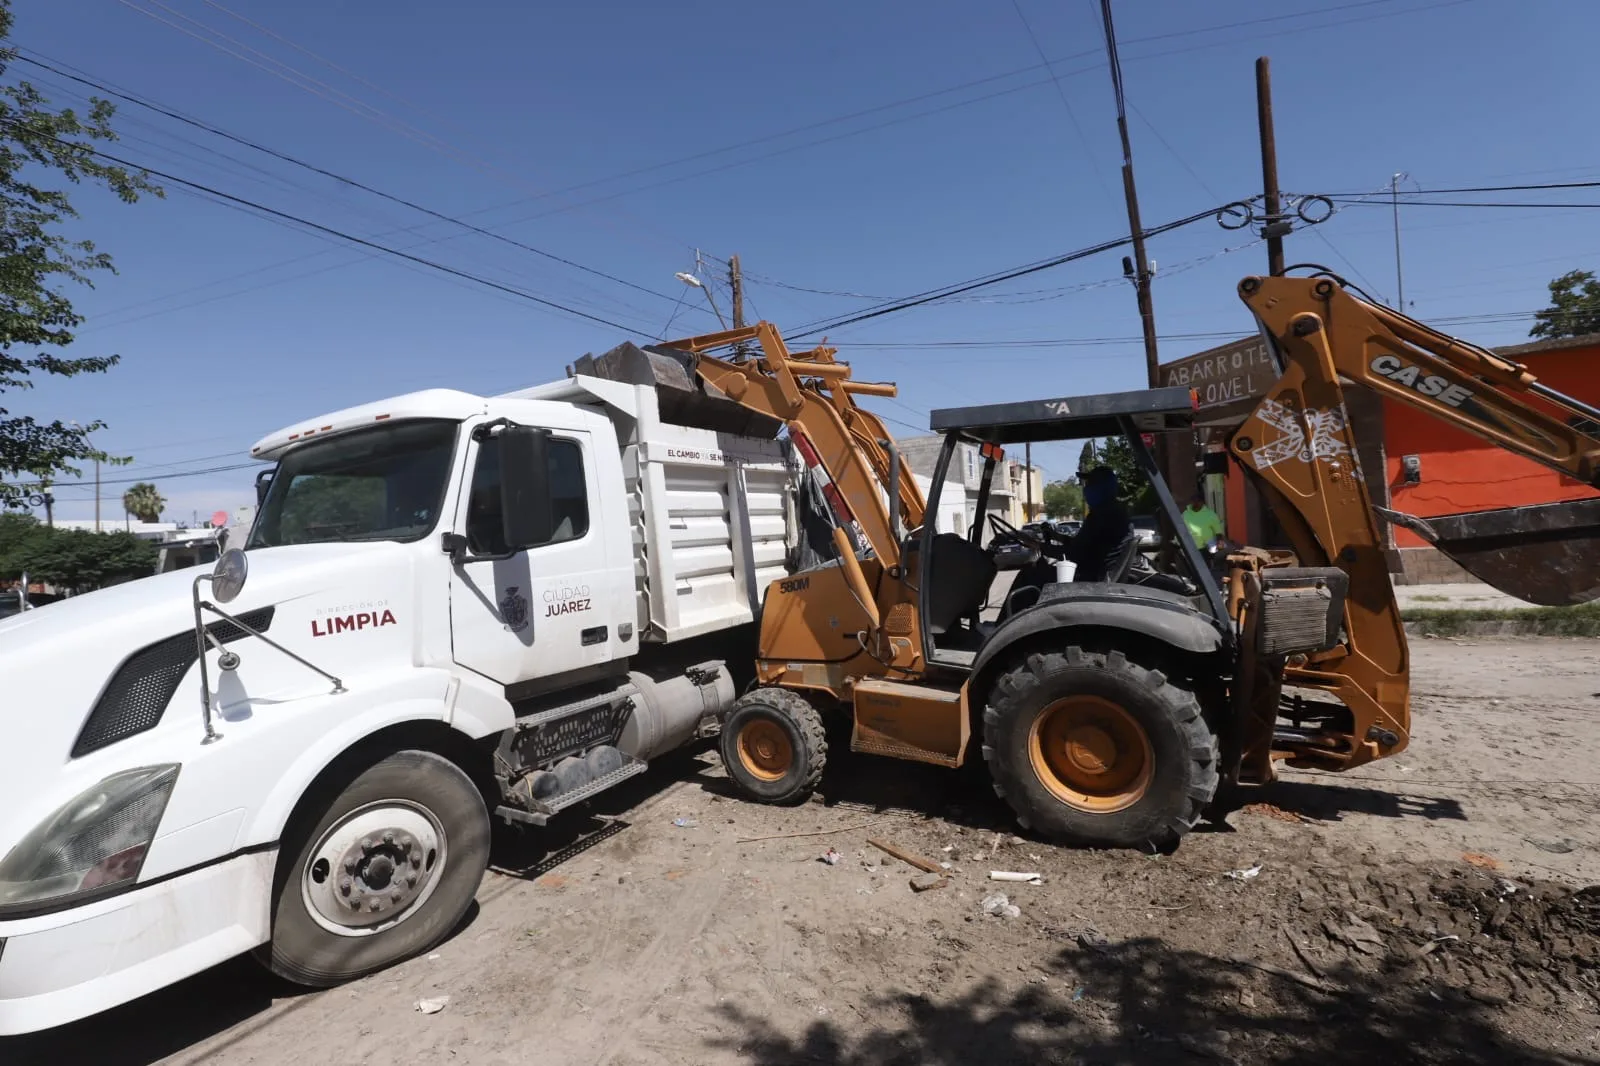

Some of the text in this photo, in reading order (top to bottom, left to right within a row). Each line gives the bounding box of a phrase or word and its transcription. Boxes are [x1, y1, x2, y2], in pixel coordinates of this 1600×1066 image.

[1167, 344, 1271, 387] ABARROTE
[1370, 355, 1475, 407] CASE
[667, 449, 676, 457] EL
[676, 450, 700, 459] CAMBIO
[542, 584, 591, 603] CIUDAD
[780, 577, 810, 594] 580M
[544, 598, 592, 618] JUÁREZ
[310, 608, 398, 638] LIMPIA
